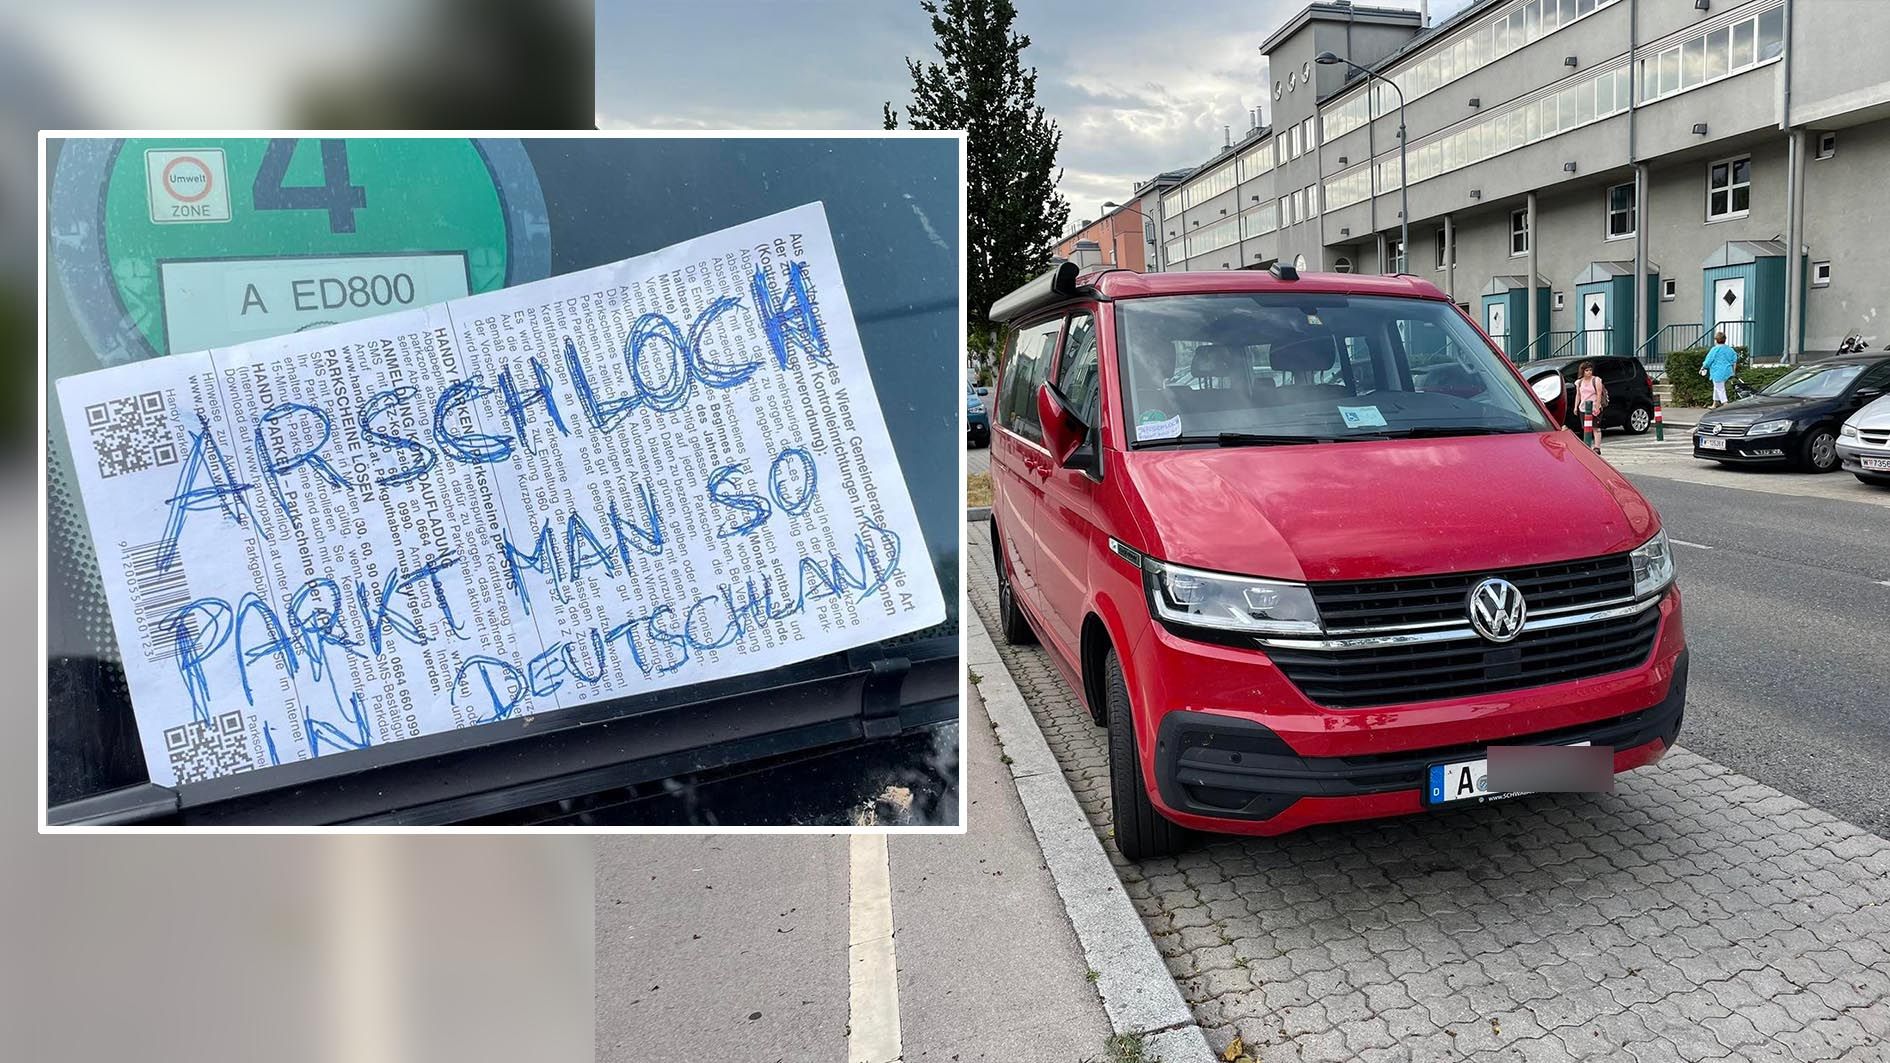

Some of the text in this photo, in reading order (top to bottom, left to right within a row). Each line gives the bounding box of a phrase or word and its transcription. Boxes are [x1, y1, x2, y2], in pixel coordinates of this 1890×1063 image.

[169, 174, 206, 184] Umwelt
[171, 204, 211, 217] ZONE
[253, 139, 367, 233] 4
[698, 261, 714, 295] schein
[241, 272, 415, 315] A ED800
[434, 327, 457, 375] HANDY
[463, 330, 477, 352] wird
[474, 318, 522, 470] der die
[553, 300, 609, 475] hinter diese gut
[772, 237, 865, 517] der Kontrolleinrichtungen in
[165, 388, 189, 460] Handy Parken
[224, 368, 287, 590] Download auf www.handyparken.at unter
[252, 362, 314, 575] HANDY Parkscheine
[284, 356, 377, 681] erhalten Sie Kennzeichen und
[297, 353, 362, 579] Ihr gültig, wenn
[305, 491, 332, 563] sind auch mit
[310, 351, 413, 711] SMS mit Parkdauer 0664 660
[324, 348, 373, 502] PARKSCHEINE LÖSEN
[354, 342, 455, 691] Anruf 0990. Internet
[367, 340, 431, 546] SMS mit 0664
[397, 335, 491, 650] seiner Abstellung ein Parkschein aktiviert ist.
[408, 333, 506, 654] parkzone dafür sorgen, dass während
[485, 316, 580, 626] gemäß 1960 den
[500, 312, 565, 526] Auf die zur Einhaltung der
[519, 330, 600, 598] wird Parkscheine Jahr
[539, 303, 631, 601] Kraftfahrzeugen einer sonst geeigneten Stelle gut
[566, 297, 651, 572] Der Parkschein ist mit
[579, 294, 665, 571] Parkschein zeitlich ist
[592, 291, 685, 600] Parkscheines bzw. mit einem
[606, 288, 695, 582] Die roten, blauen, grünen, gelben oder
[658, 273, 754, 573] Minute) des Jahres wobei
[660, 432, 696, 540] Daten bezeichnen.
[671, 269, 767, 574] haltbares Beginnes (Monat,
[684, 265, 805, 641] Die hat und
[688, 436, 742, 584] gelassen Bei
[728, 315, 832, 632] mit Park-
[740, 307, 844, 629] haben zu sorgen, der seiner
[775, 373, 834, 548] mehrspuriges in einer
[789, 232, 914, 611] Aus des Wiener Gemeinderates die Art
[121, 554, 153, 657] 120055 060123
[159, 448, 818, 729] PARKT MAN SO
[202, 371, 305, 742] Hinweise zur der Parkgebühr Internet
[263, 516, 901, 765] IN DEUTSCHLAND
[395, 549, 439, 696] muss werden.
[463, 474, 509, 626] mehrspuriges Kraftfahrzeug
[675, 432, 746, 656] auf jedem Parkschein die der
[1433, 766, 1474, 796] D A
